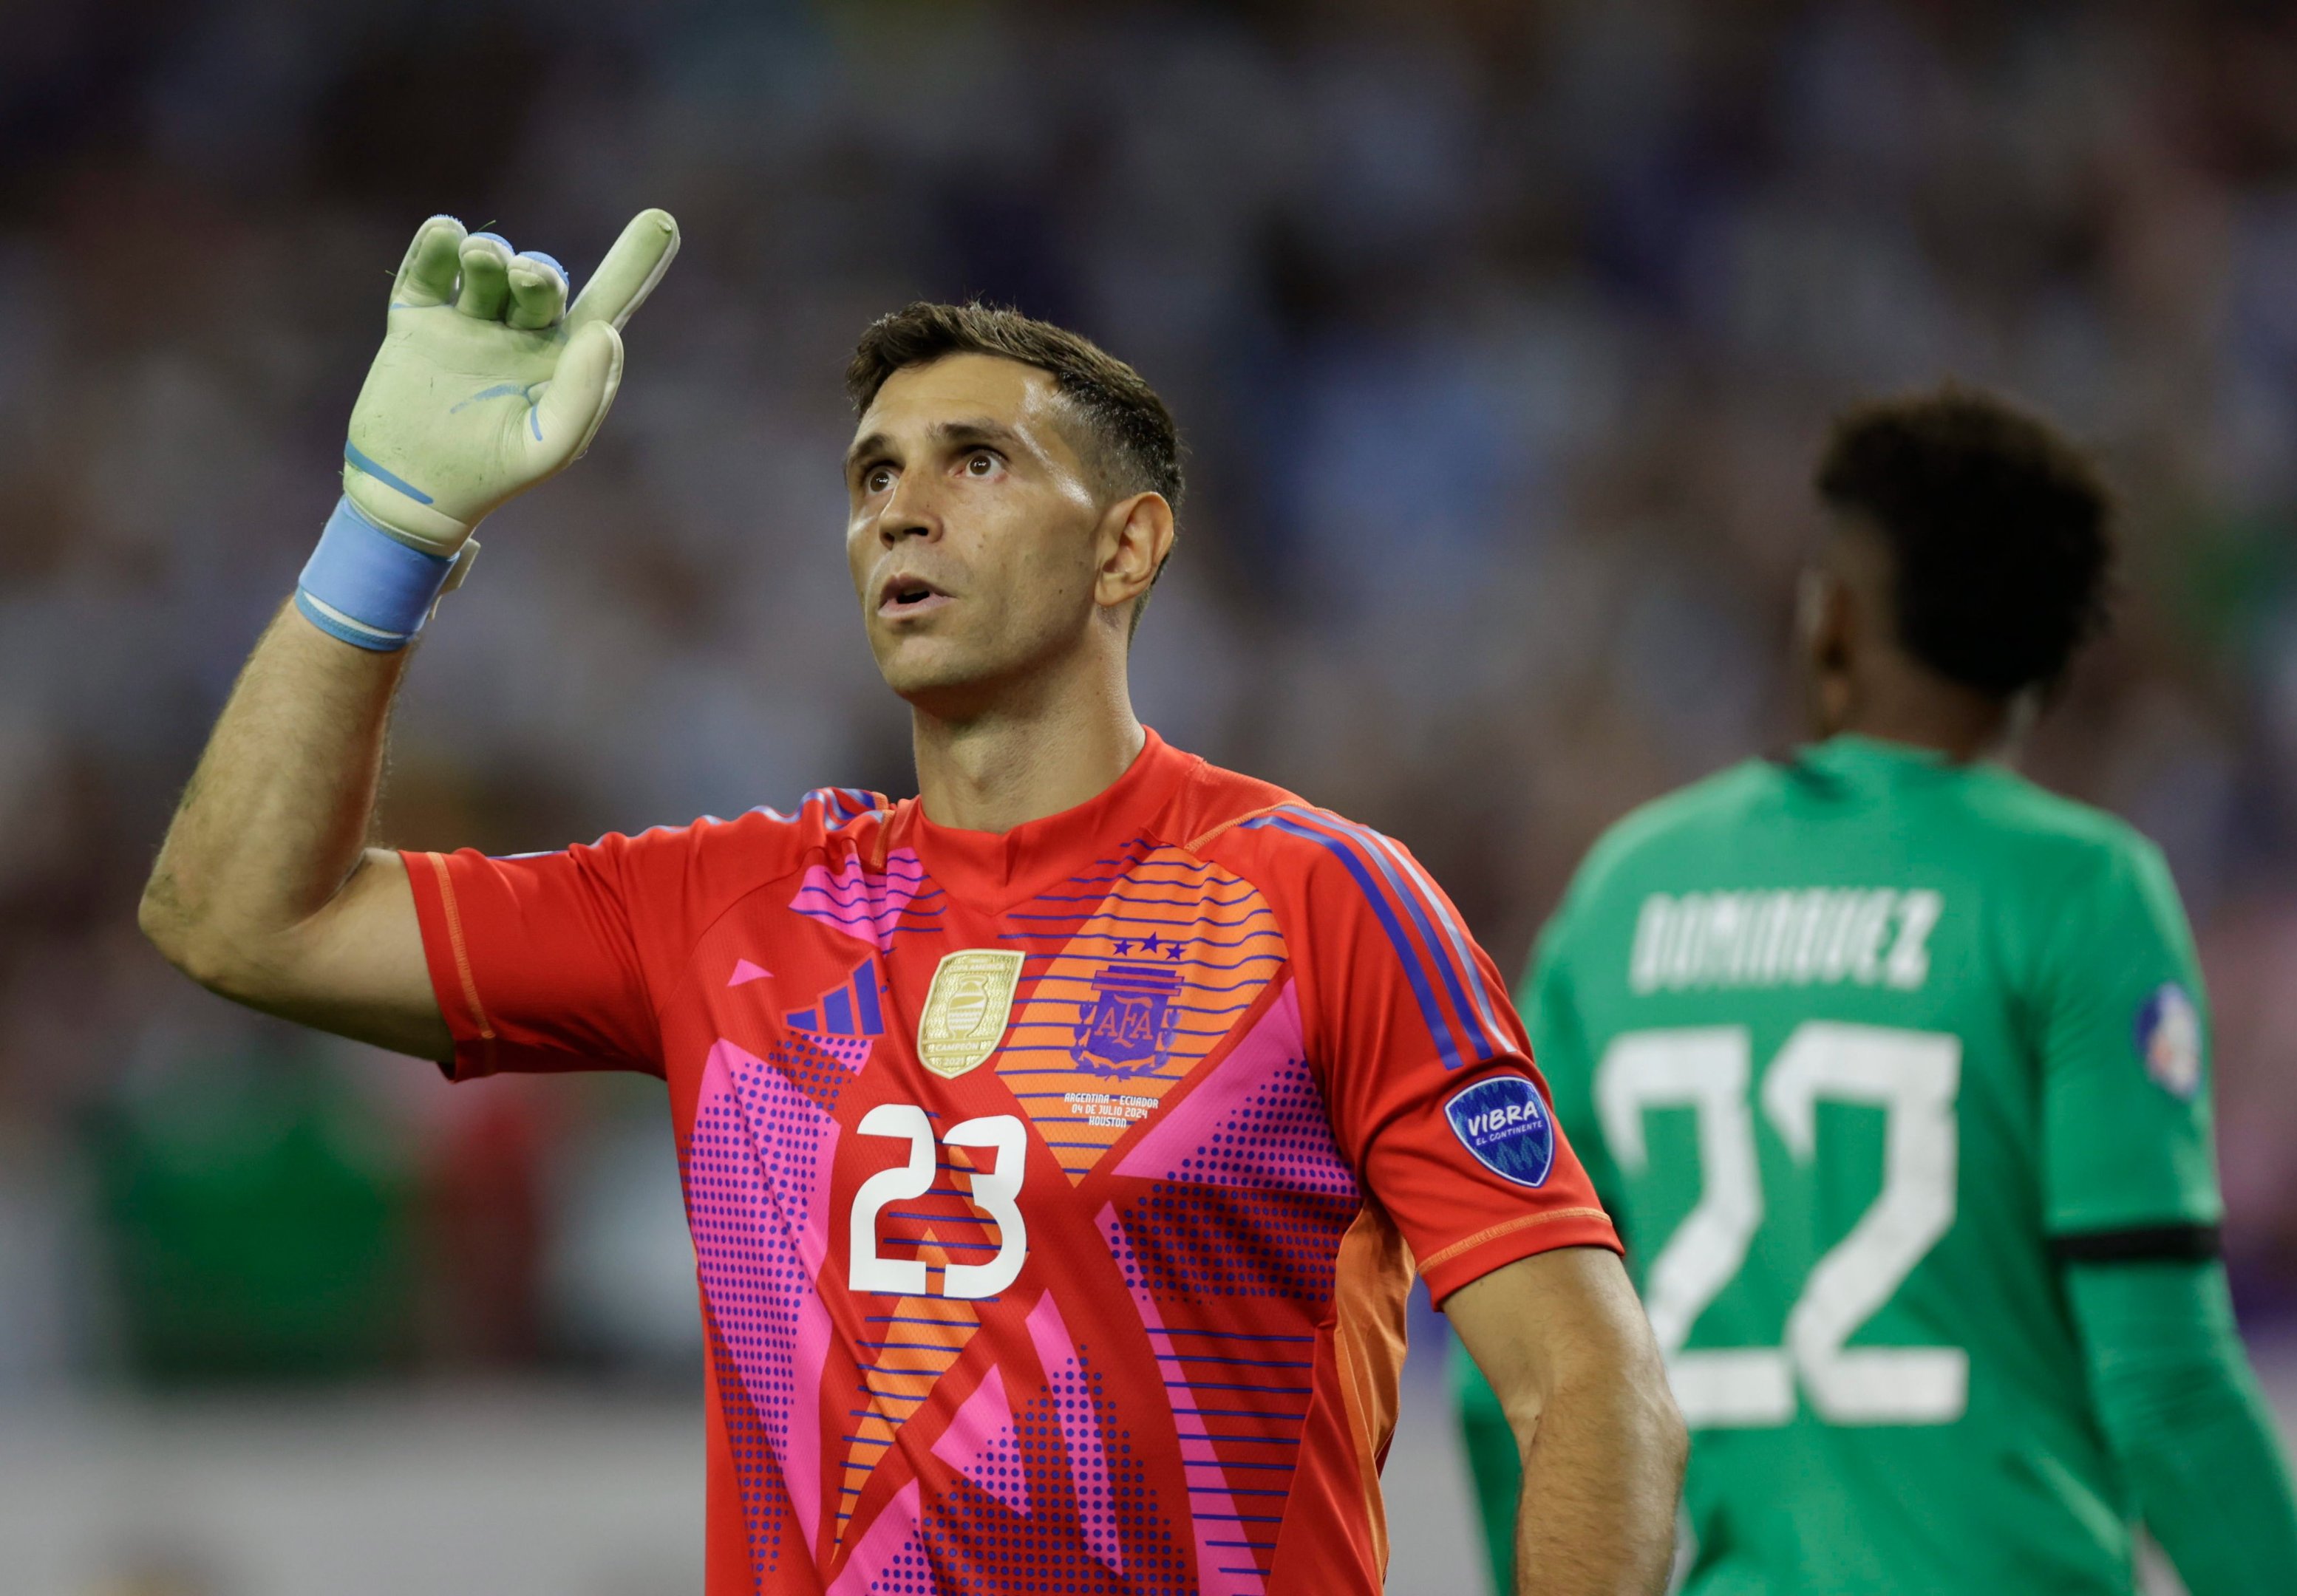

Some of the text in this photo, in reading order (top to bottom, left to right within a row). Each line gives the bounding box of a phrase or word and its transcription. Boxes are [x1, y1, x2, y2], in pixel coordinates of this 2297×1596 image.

[950, 964, 967, 972] COPA
[1094, 993, 1154, 1048] AFA
[945, 1057, 965, 1065] 2021
[1064, 1093, 1110, 1103] ARGENTINA
[1120, 1096, 1159, 1108] ECUADOR
[1072, 1103, 1148, 1119] 04 DE JULIO 2024
[1089, 1116, 1127, 1128] HOUSTON
[1468, 1101, 1539, 1136] VIBRA
[1476, 1120, 1543, 1146] EL CONTINENTE
[849, 1103, 1027, 1298] 23
[1595, 1021, 1970, 1427] 22
